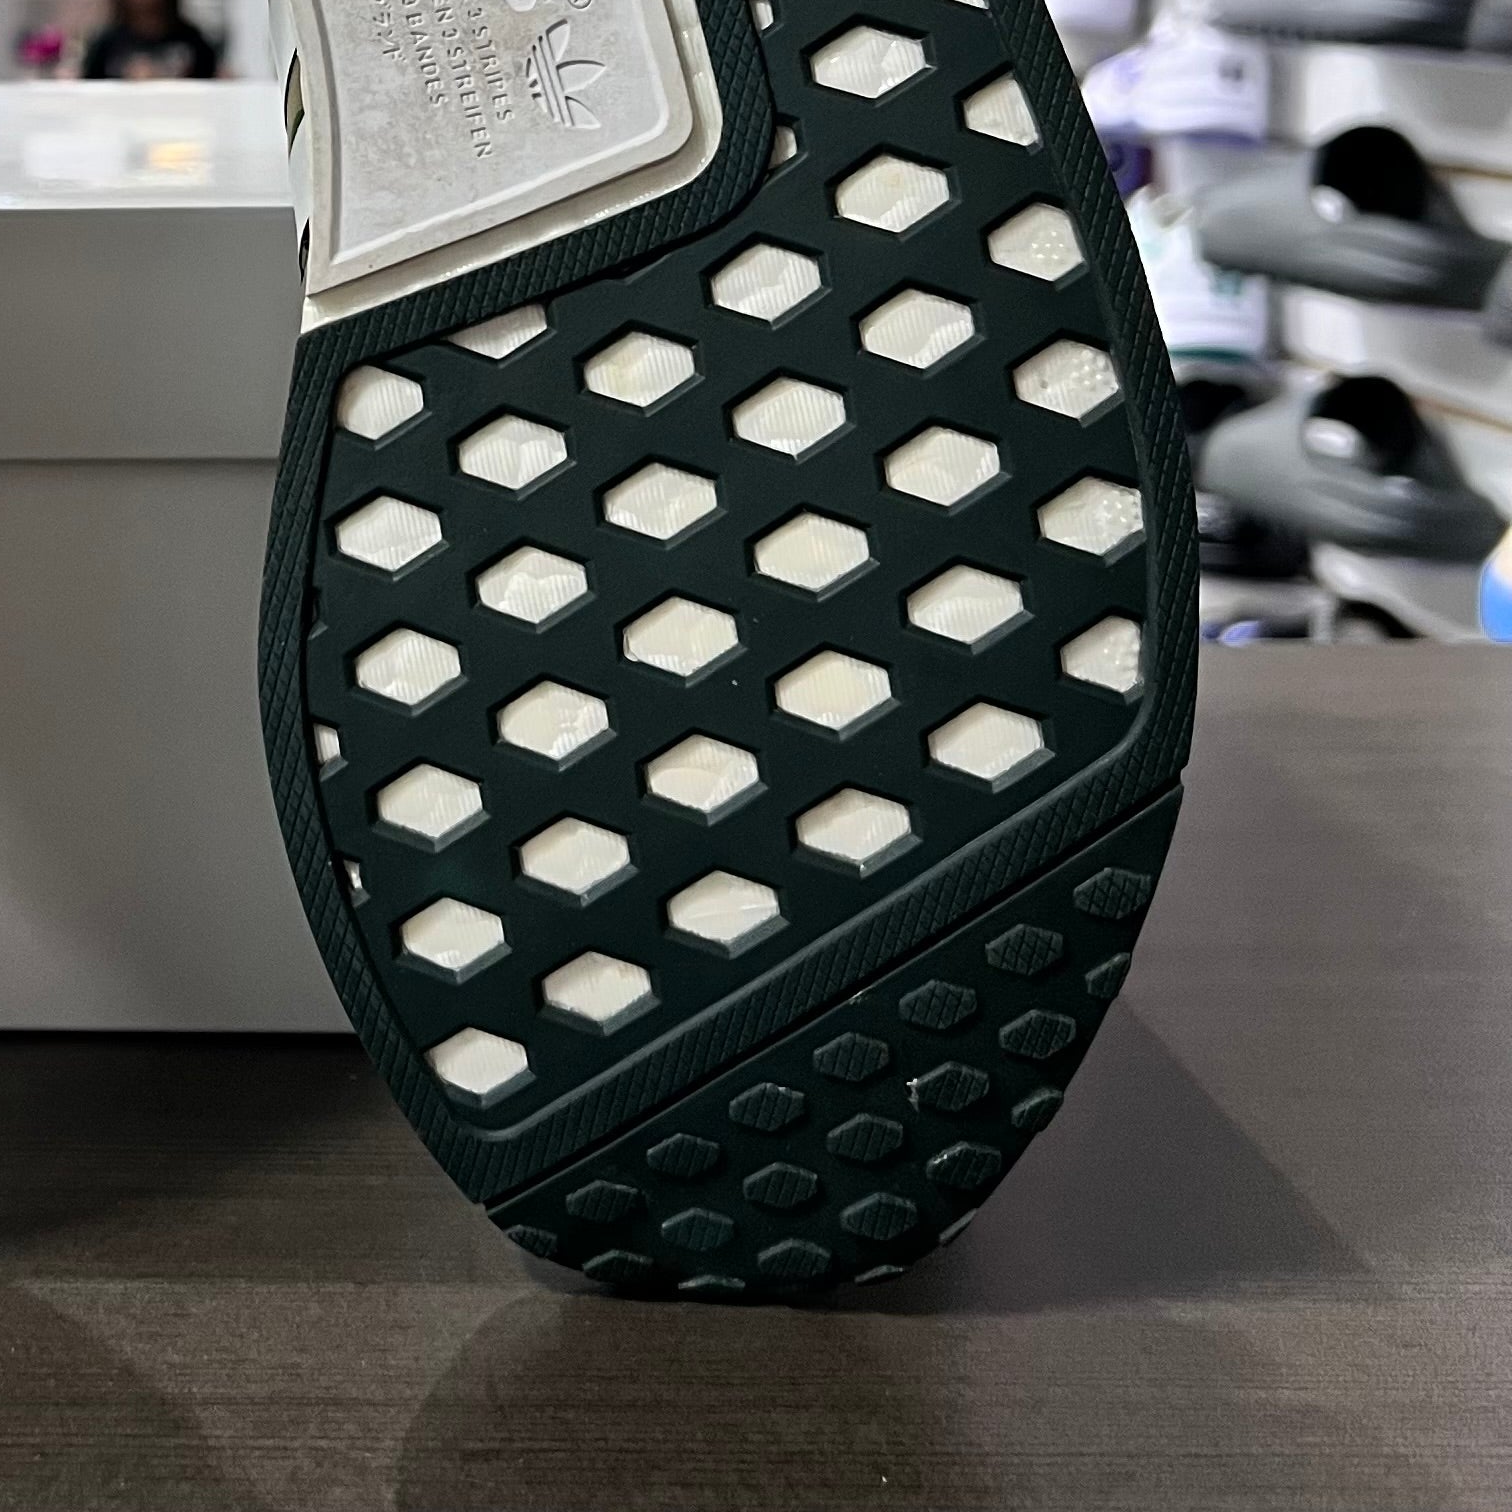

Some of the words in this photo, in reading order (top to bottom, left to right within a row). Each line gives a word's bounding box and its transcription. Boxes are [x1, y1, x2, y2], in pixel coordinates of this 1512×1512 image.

[406, 12, 449, 107] BANDES
[447, 46, 493, 159] STREIFEN
[472, 25, 515, 123] STRIPES
